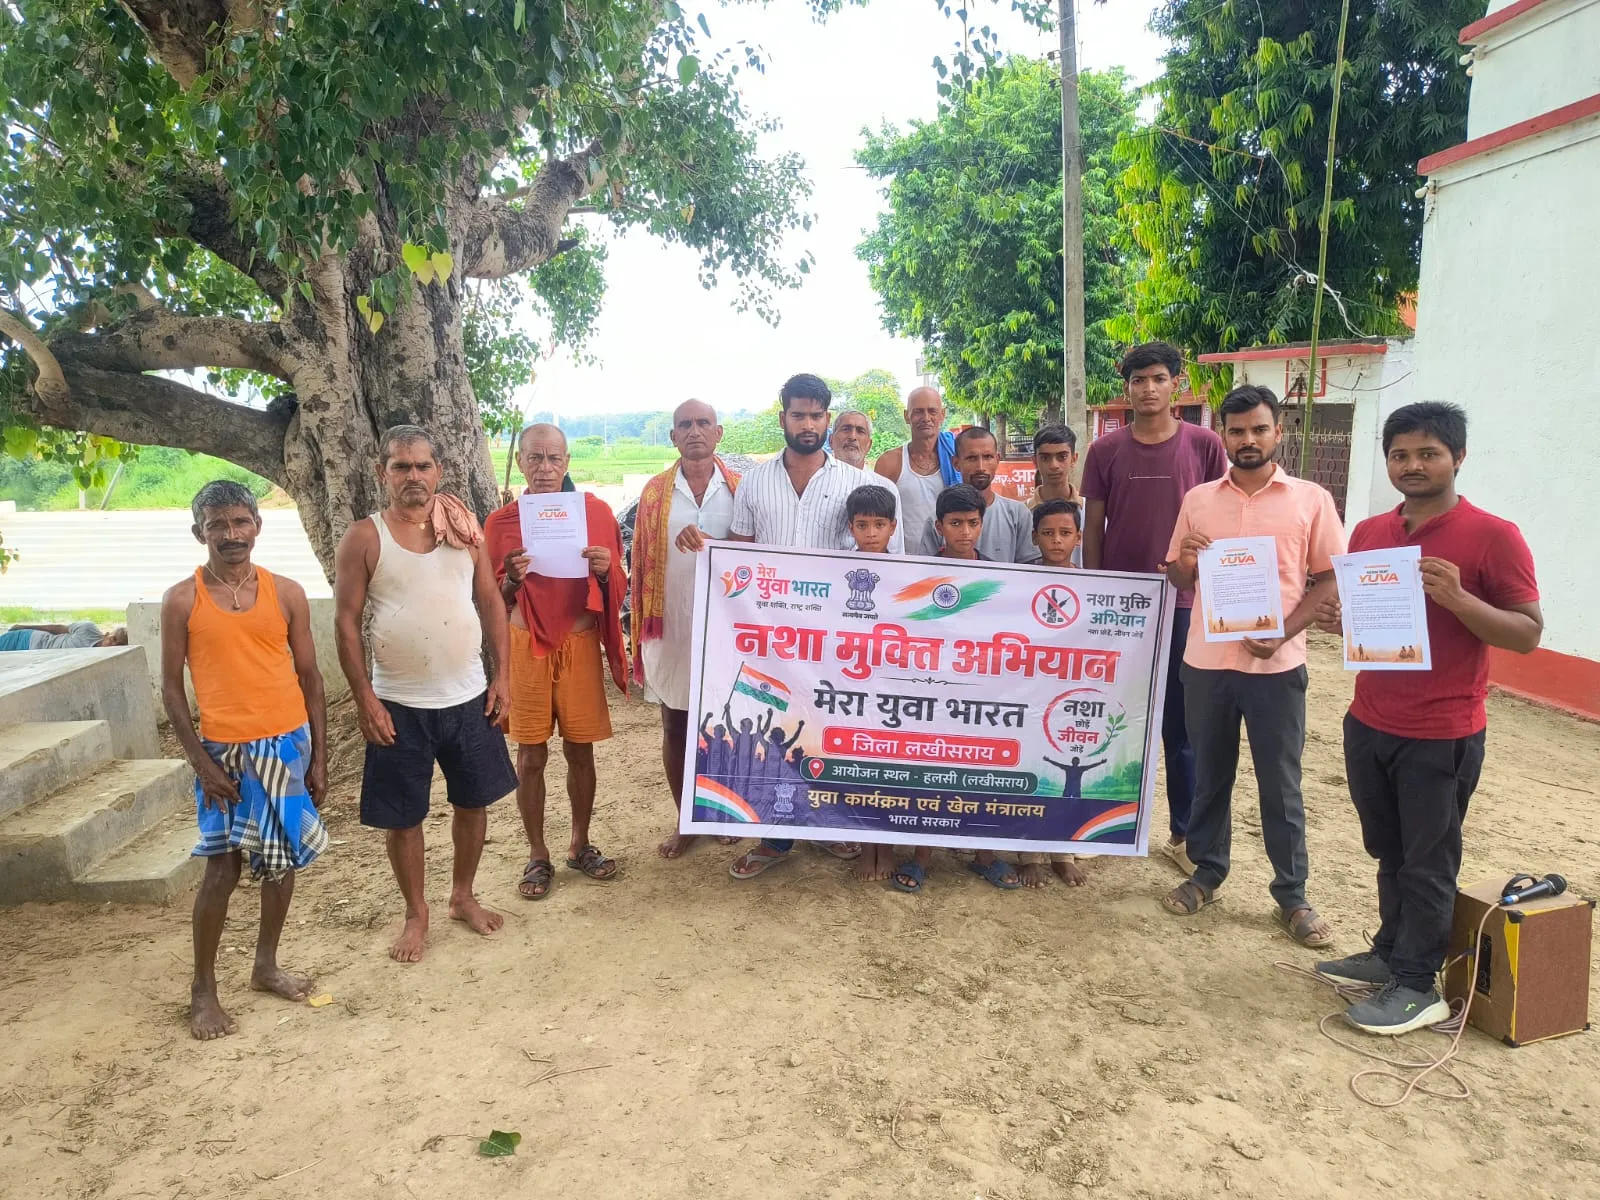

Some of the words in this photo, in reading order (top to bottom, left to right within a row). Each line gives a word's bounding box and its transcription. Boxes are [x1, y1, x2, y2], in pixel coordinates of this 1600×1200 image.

[1220, 555, 1255, 565] YUVA
[757, 563, 776, 578] मेरा
[1359, 573, 1398, 582] YUVA
[756, 577, 791, 599] युवा
[792, 580, 832, 598] भारत
[1086, 593, 1115, 607] नशा
[1119, 592, 1152, 613] मुक्ति
[1090, 610, 1147, 627] अभियान
[734, 623, 827, 662] नशा
[835, 623, 944, 680] मुक्ति
[952, 632, 1121, 684] अभियान
[813, 680, 868, 716] मेरा
[876, 693, 938, 728] युवा
[946, 698, 1028, 728] भारत
[1064, 700, 1106, 718] नशा
[1057, 727, 1099, 744] जीवन
[852, 733, 898, 754] जिला
[905, 738, 995, 761] लखीसराय
[832, 765, 880, 779] आयोजन
[883, 769, 910, 781] स्थल
[923, 771, 958, 785] हलसी
[962, 774, 1029, 791] (लखीसराय)
[808, 790, 838, 808] युवा
[844, 790, 910, 810] कार्यक्रम
[917, 796, 941, 812] एवं
[947, 796, 979, 814] खेल
[985, 802, 1045, 818] मंत्रालय
[889, 814, 917, 826] भारत
[921, 817, 961, 828] सरकार
